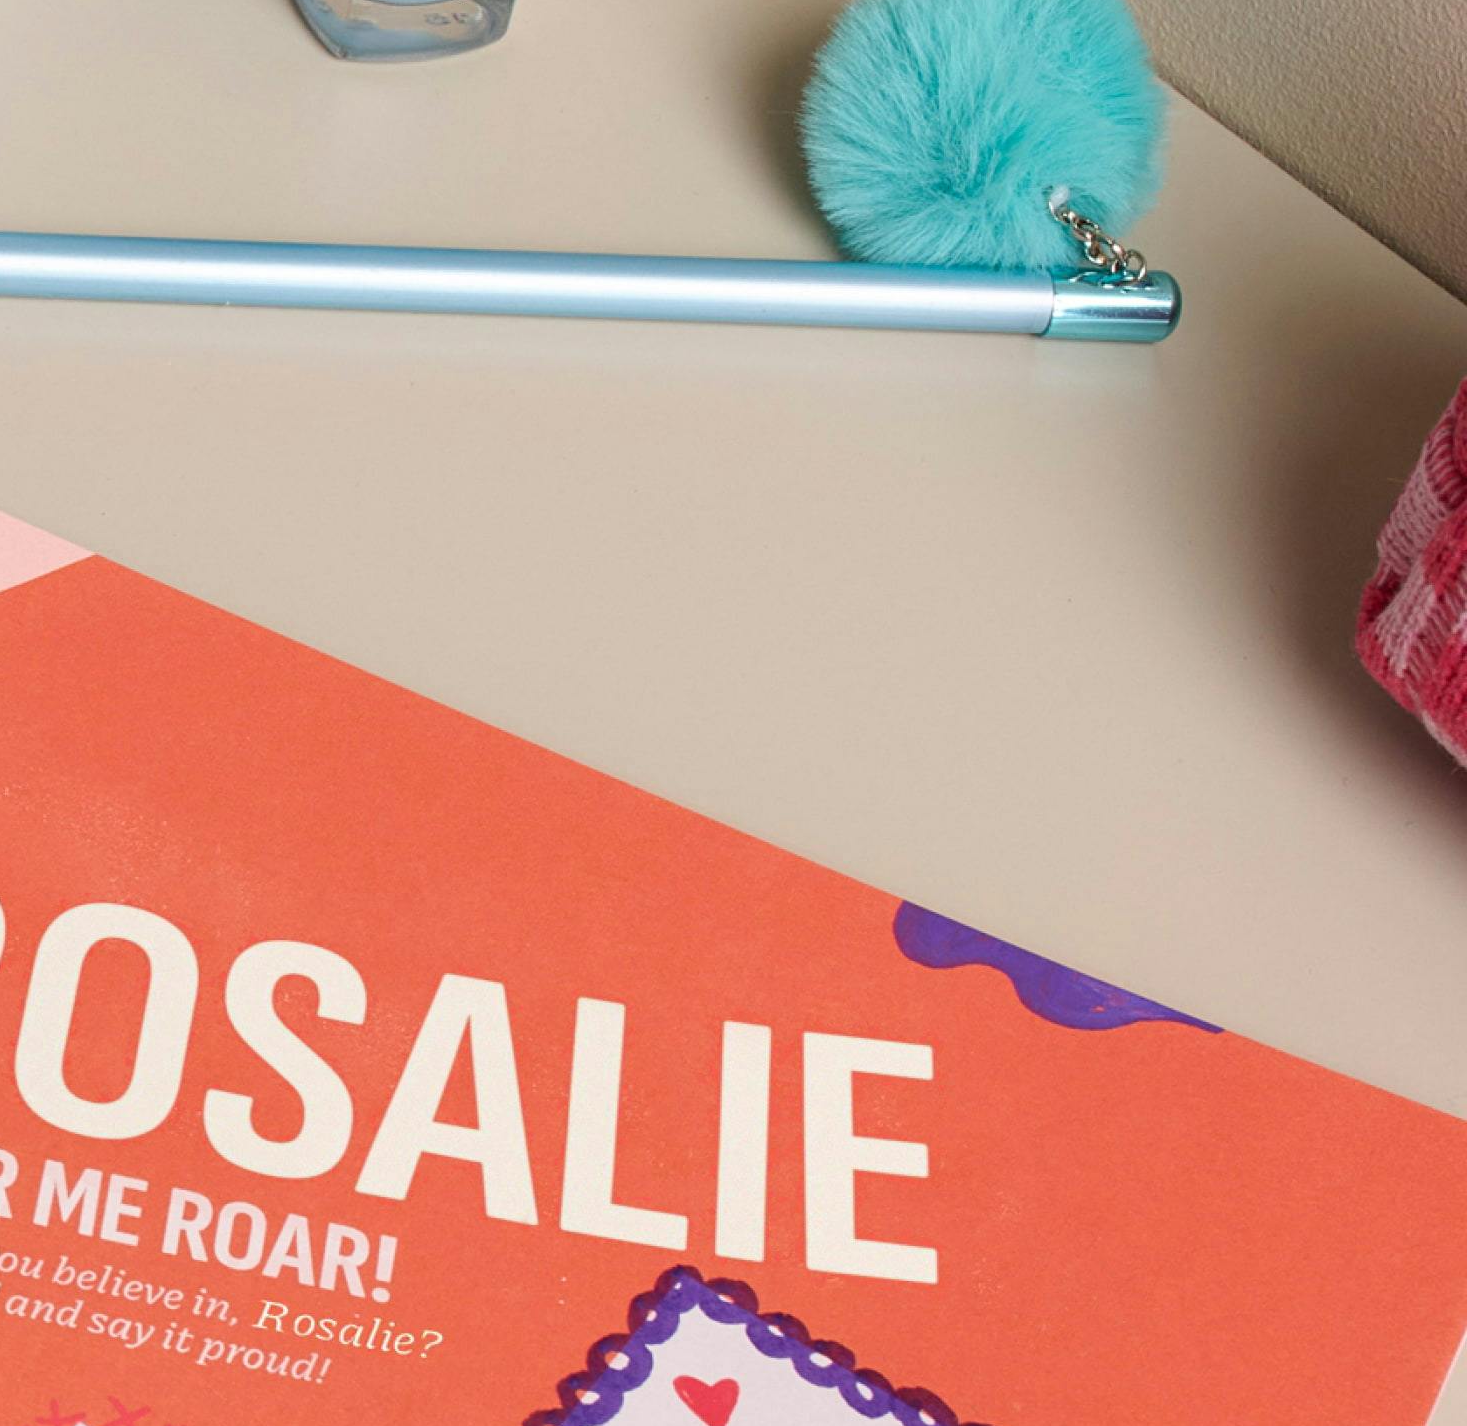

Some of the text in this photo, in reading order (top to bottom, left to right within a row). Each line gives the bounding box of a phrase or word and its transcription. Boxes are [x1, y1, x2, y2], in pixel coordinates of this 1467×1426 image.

[33, 1159, 149, 1247] ME
[161, 1187, 400, 1304] ROAR!
[4, 1294, 85, 1330] and
[87, 1309, 156, 1350] say
[162, 1322, 195, 1354] it
[196, 1334, 333, 1385] proud!
[51, 1254, 185, 1311] believe
[192, 1287, 239, 1327] in,
[252, 1298, 444, 1359] Rosalie?
